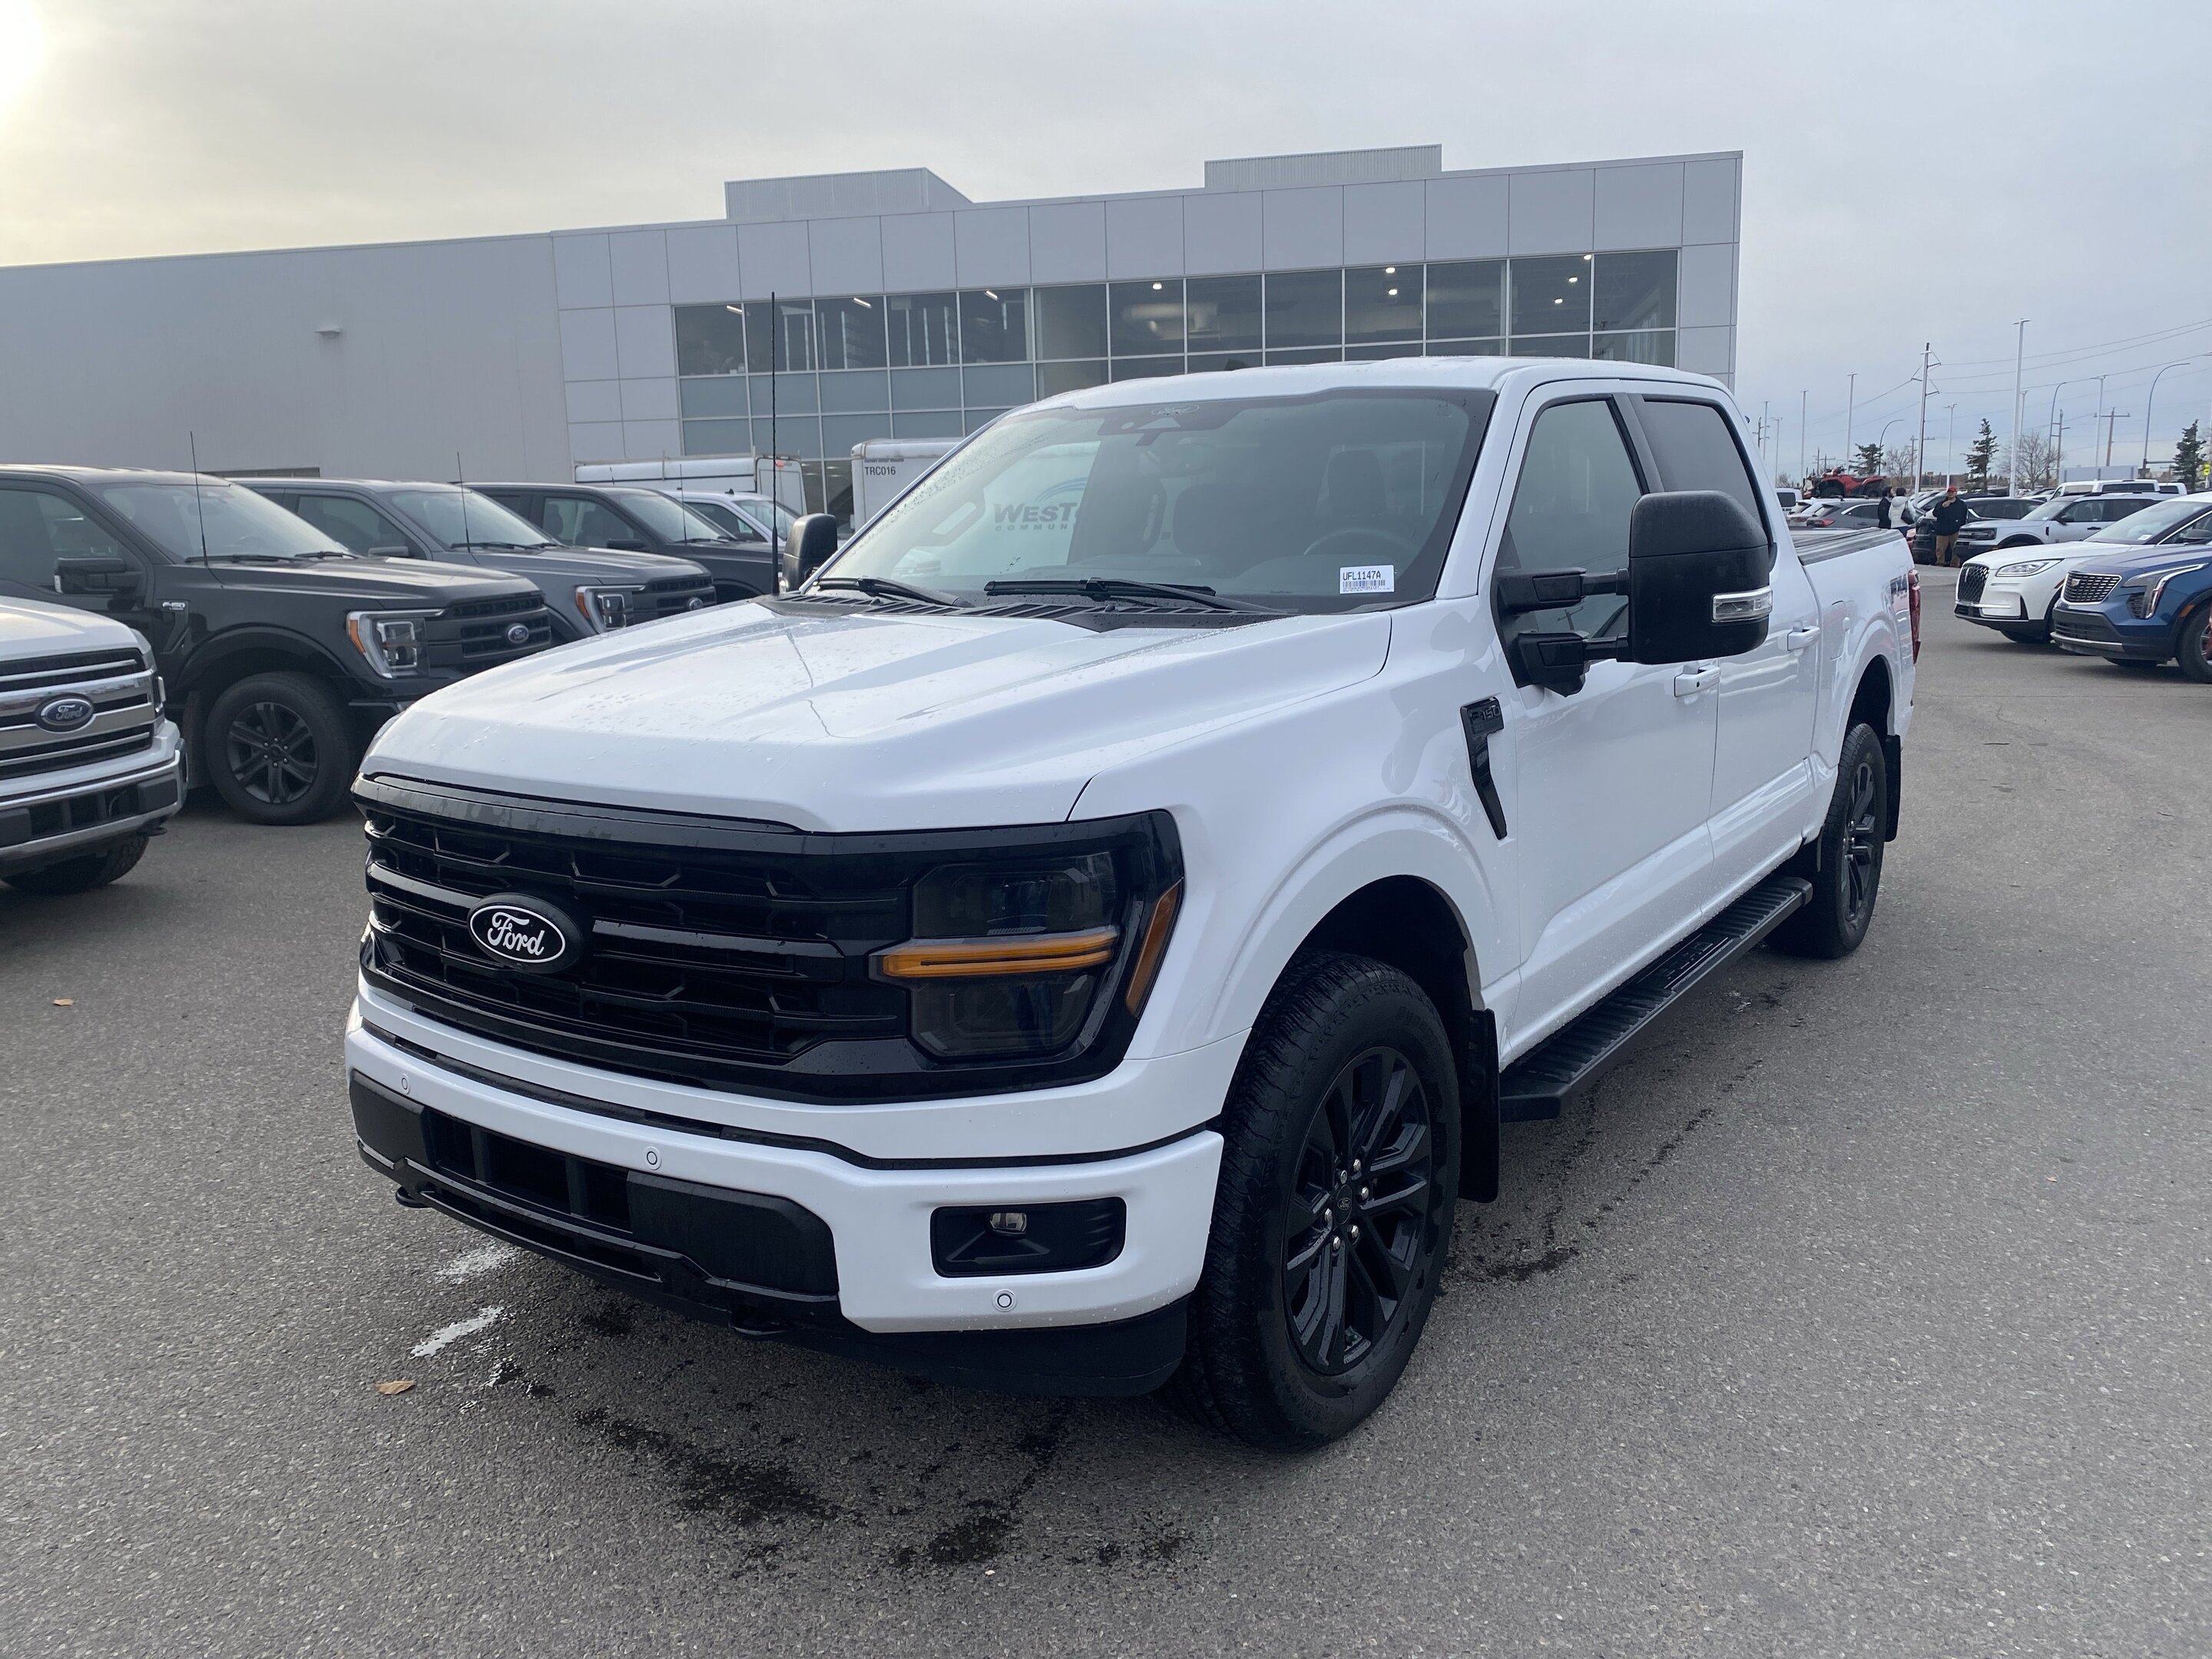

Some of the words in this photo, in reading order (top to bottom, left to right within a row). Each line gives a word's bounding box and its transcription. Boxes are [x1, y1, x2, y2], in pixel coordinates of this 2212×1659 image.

[864, 466, 896, 475] TRC016
[993, 502, 1079, 523] WEST
[1343, 571, 1381, 581] UFL1147A
[55, 704, 83, 720] Ford
[487, 911, 545, 956] Ford
